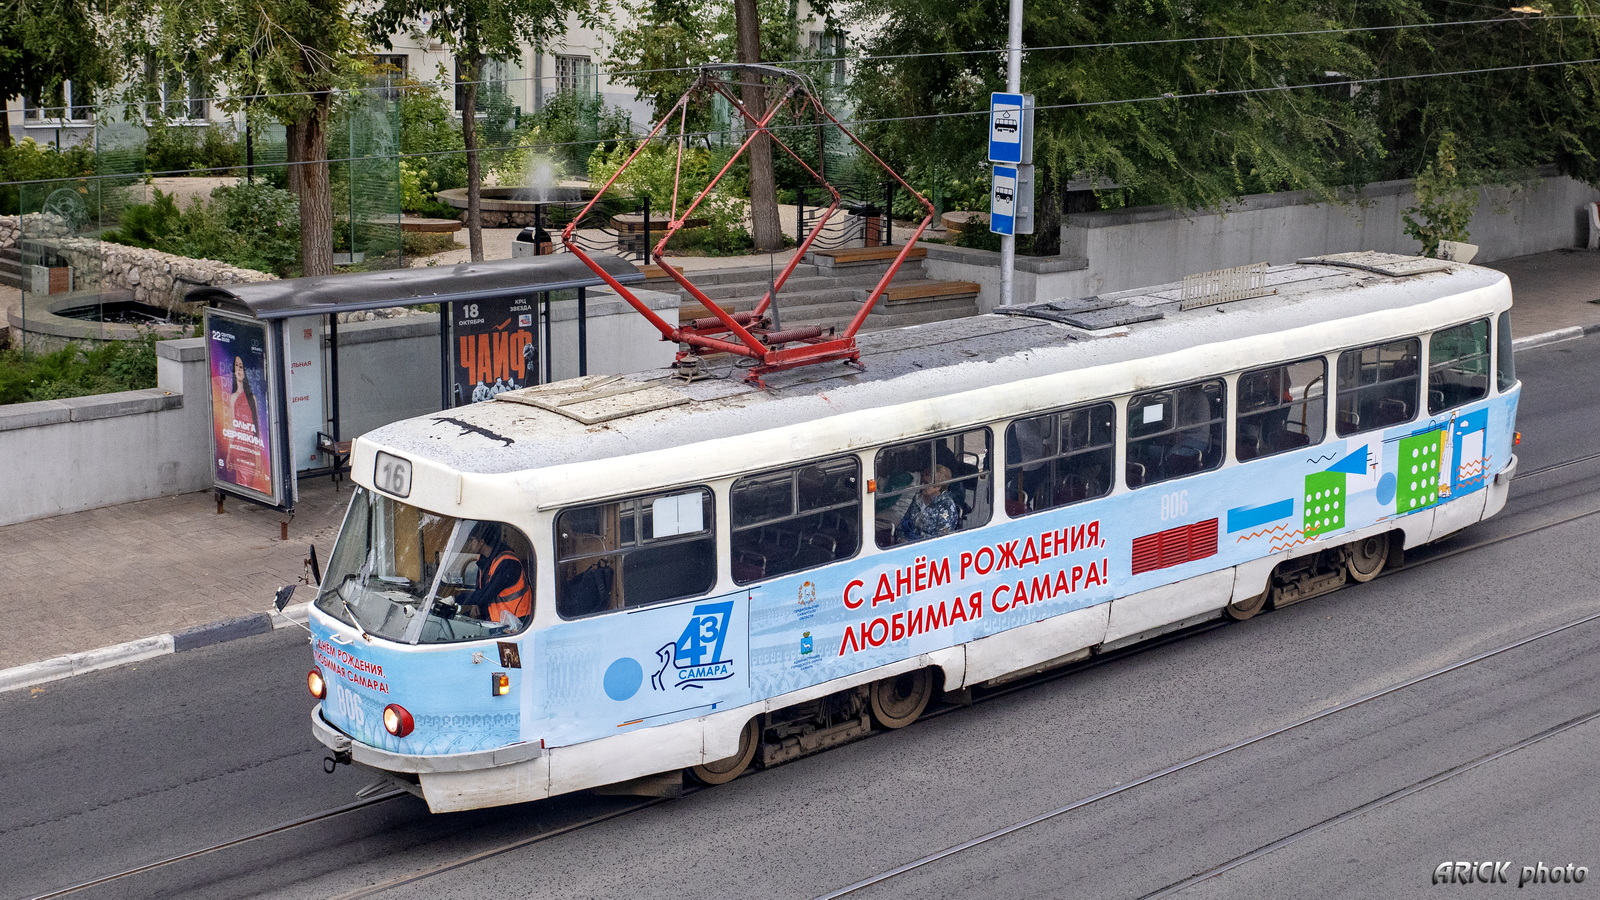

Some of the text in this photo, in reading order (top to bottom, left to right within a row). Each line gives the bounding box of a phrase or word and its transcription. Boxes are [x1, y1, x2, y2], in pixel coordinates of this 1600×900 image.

[458, 318, 485, 326] ОКТЯБРЯ
[463, 303, 479, 319] 18
[211, 330, 222, 341] 22
[460, 317, 533, 385] ЧАЙФ
[222, 428, 265, 448] СЕРЯБКИНА
[232, 419, 257, 433] ОЛЬГА
[383, 461, 406, 492] 16
[1160, 489, 1189, 521] 806
[843, 520, 1106, 609] С ДНЁМ РОЖДЕНИЯ,
[838, 558, 1109, 656] ЛЮБИМАЯ САМАРА!
[313, 650, 390, 694] ЛЮБИМАЯ САМАРА!
[337, 649, 387, 678] РОЖДЕНИЯ,
[678, 664, 729, 680] САМАРА
[336, 684, 365, 726] 806
